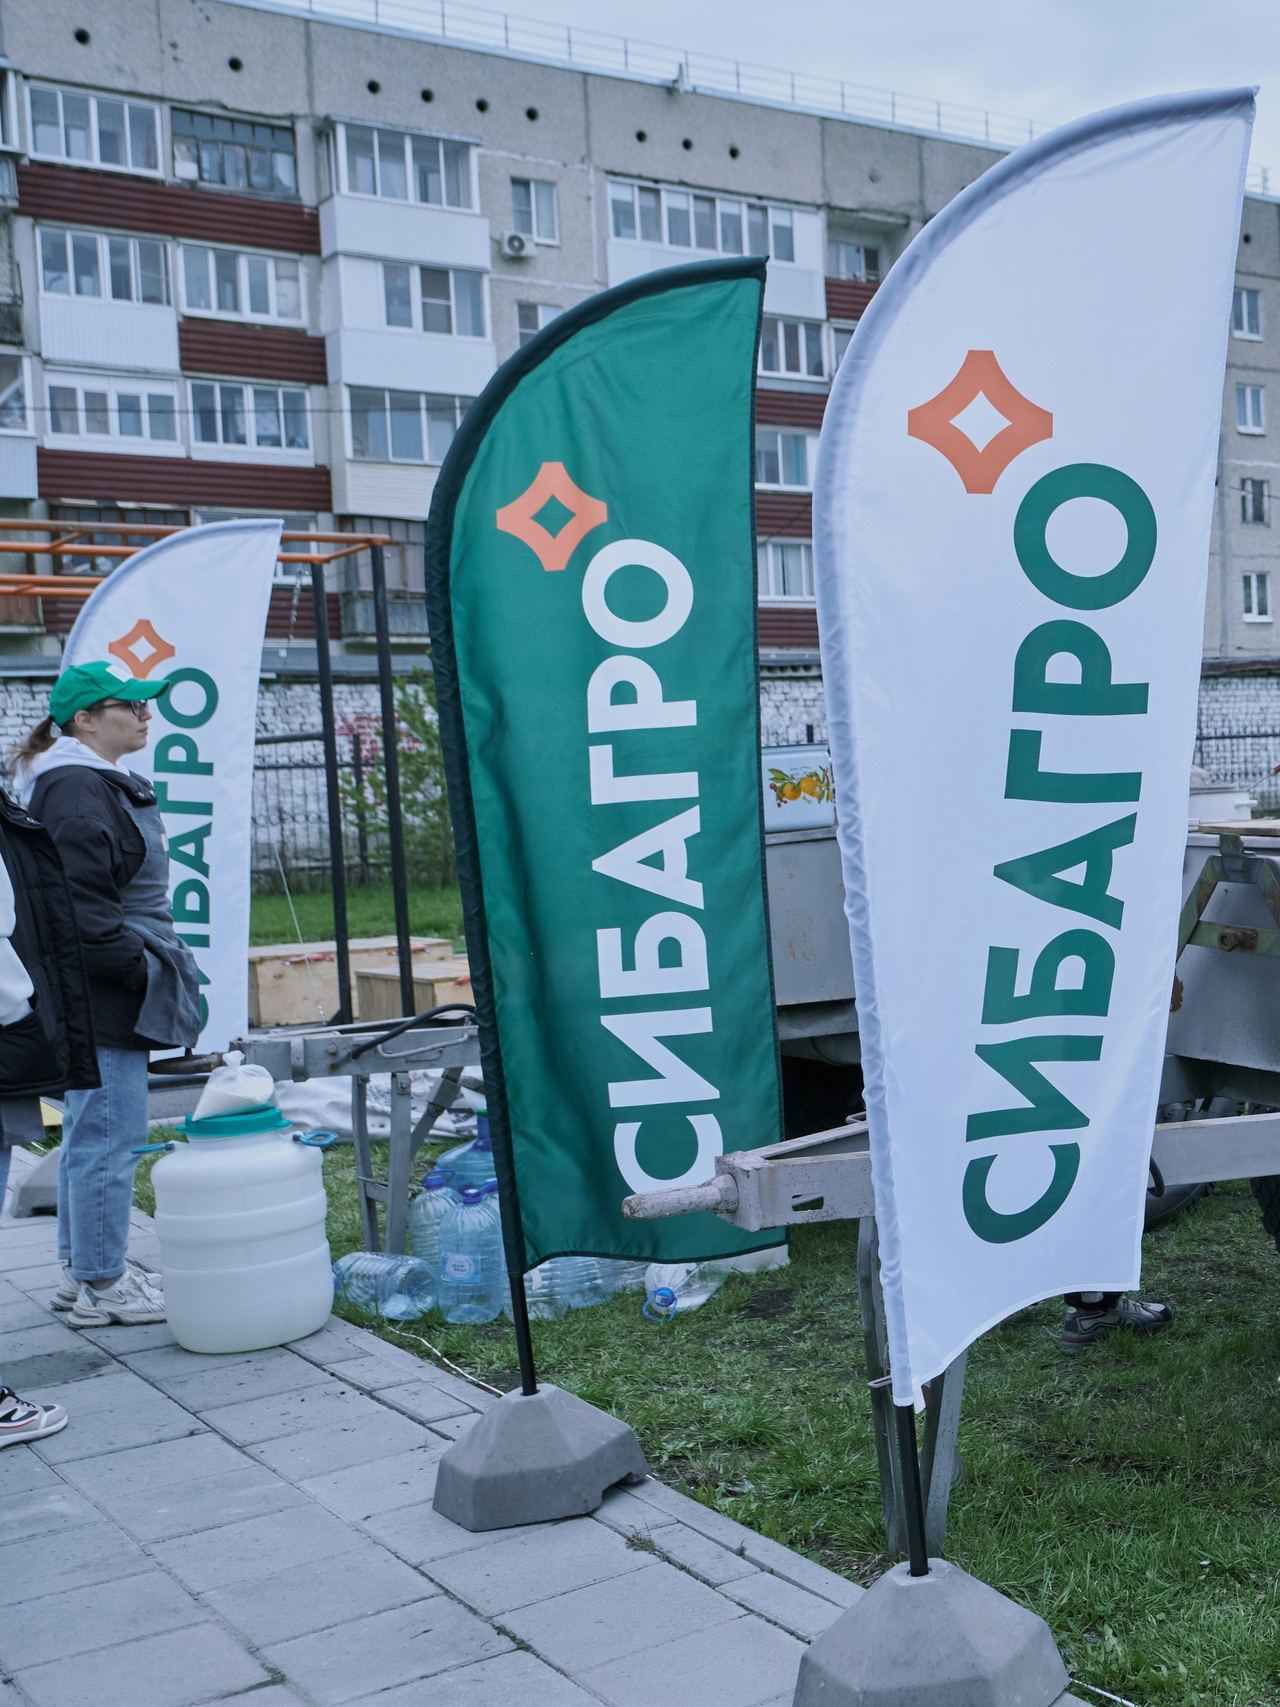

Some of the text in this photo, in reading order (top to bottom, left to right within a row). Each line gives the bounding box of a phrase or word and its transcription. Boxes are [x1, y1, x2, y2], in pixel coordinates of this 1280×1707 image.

[153, 667, 219, 1034] БАГРО
[582, 538, 724, 1196] СИБАГРО
[963, 463, 1158, 1244] СИБАГРО
